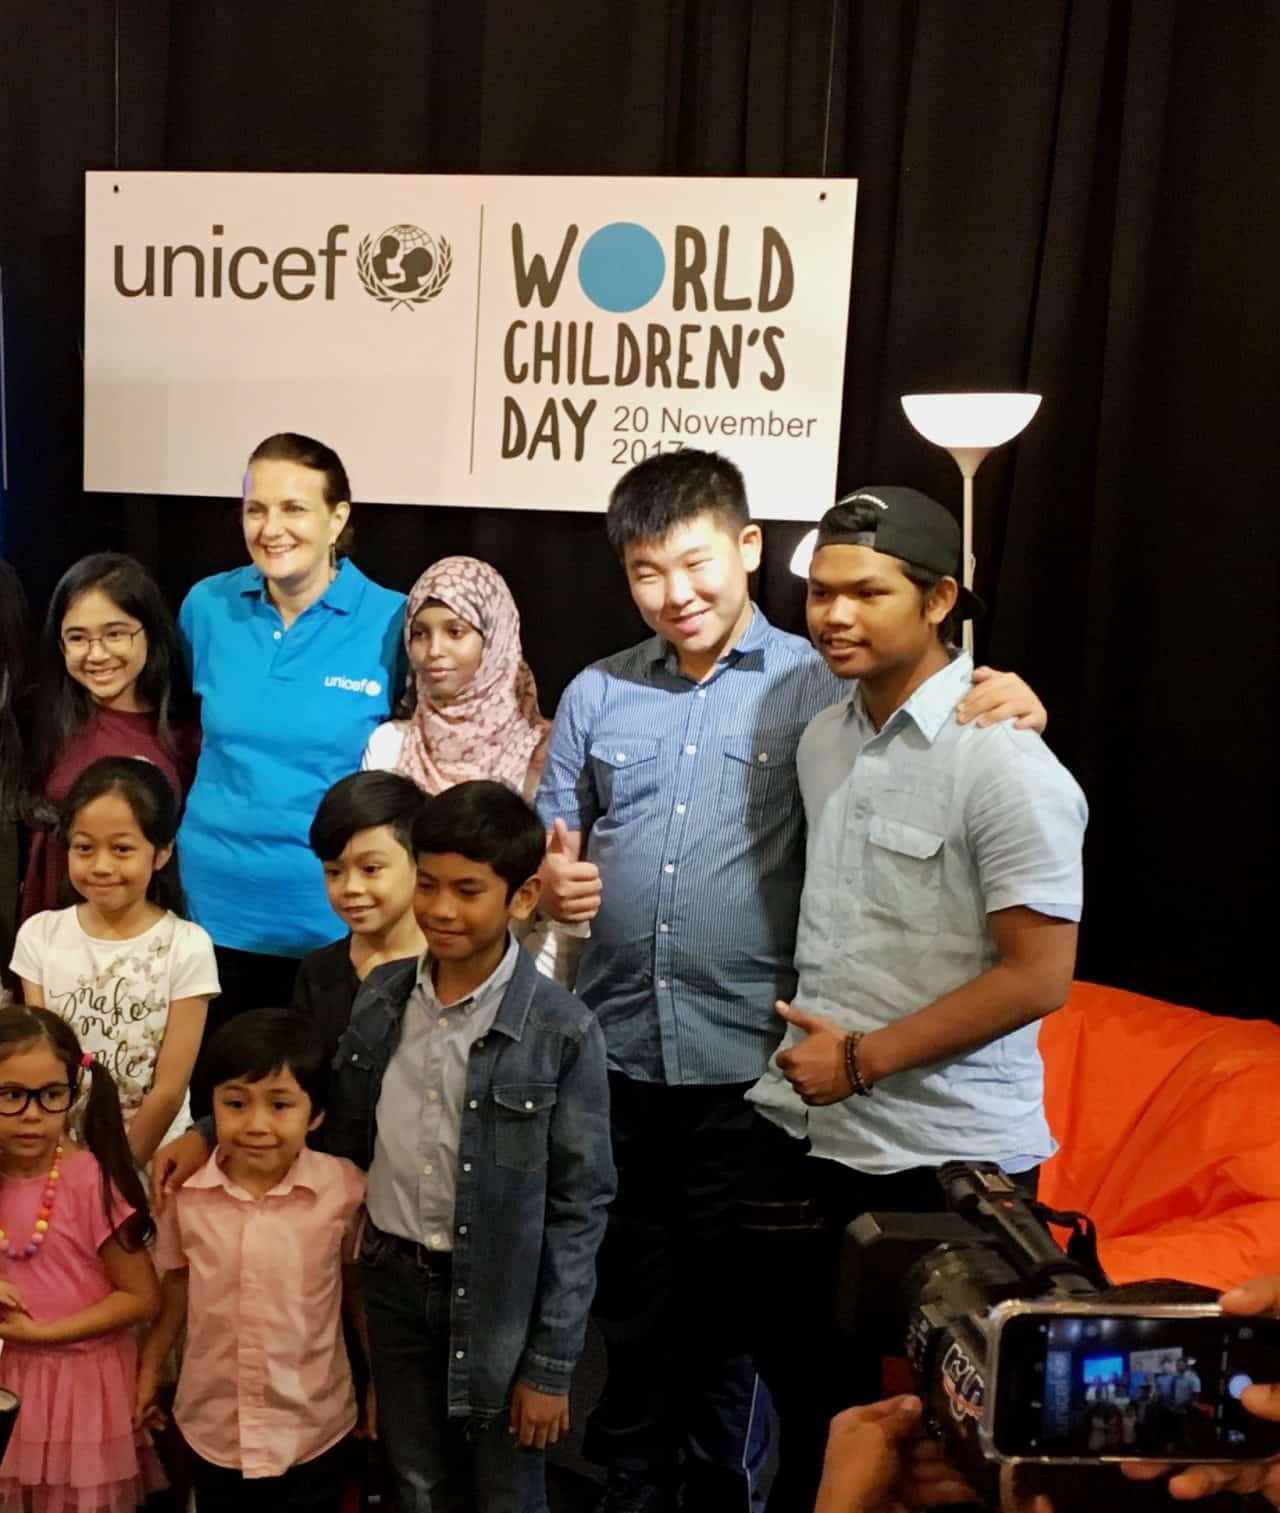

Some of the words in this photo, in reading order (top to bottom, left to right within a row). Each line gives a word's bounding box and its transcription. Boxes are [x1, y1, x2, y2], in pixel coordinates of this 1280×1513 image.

[113, 224, 349, 300] unicef
[511, 221, 795, 313] WORLD
[503, 320, 785, 391] CHILDREN'S
[501, 397, 597, 462] DAY
[613, 405, 650, 433] 20
[660, 407, 818, 438] November
[324, 675, 368, 693] unicef
[79, 1015, 120, 1040] me
